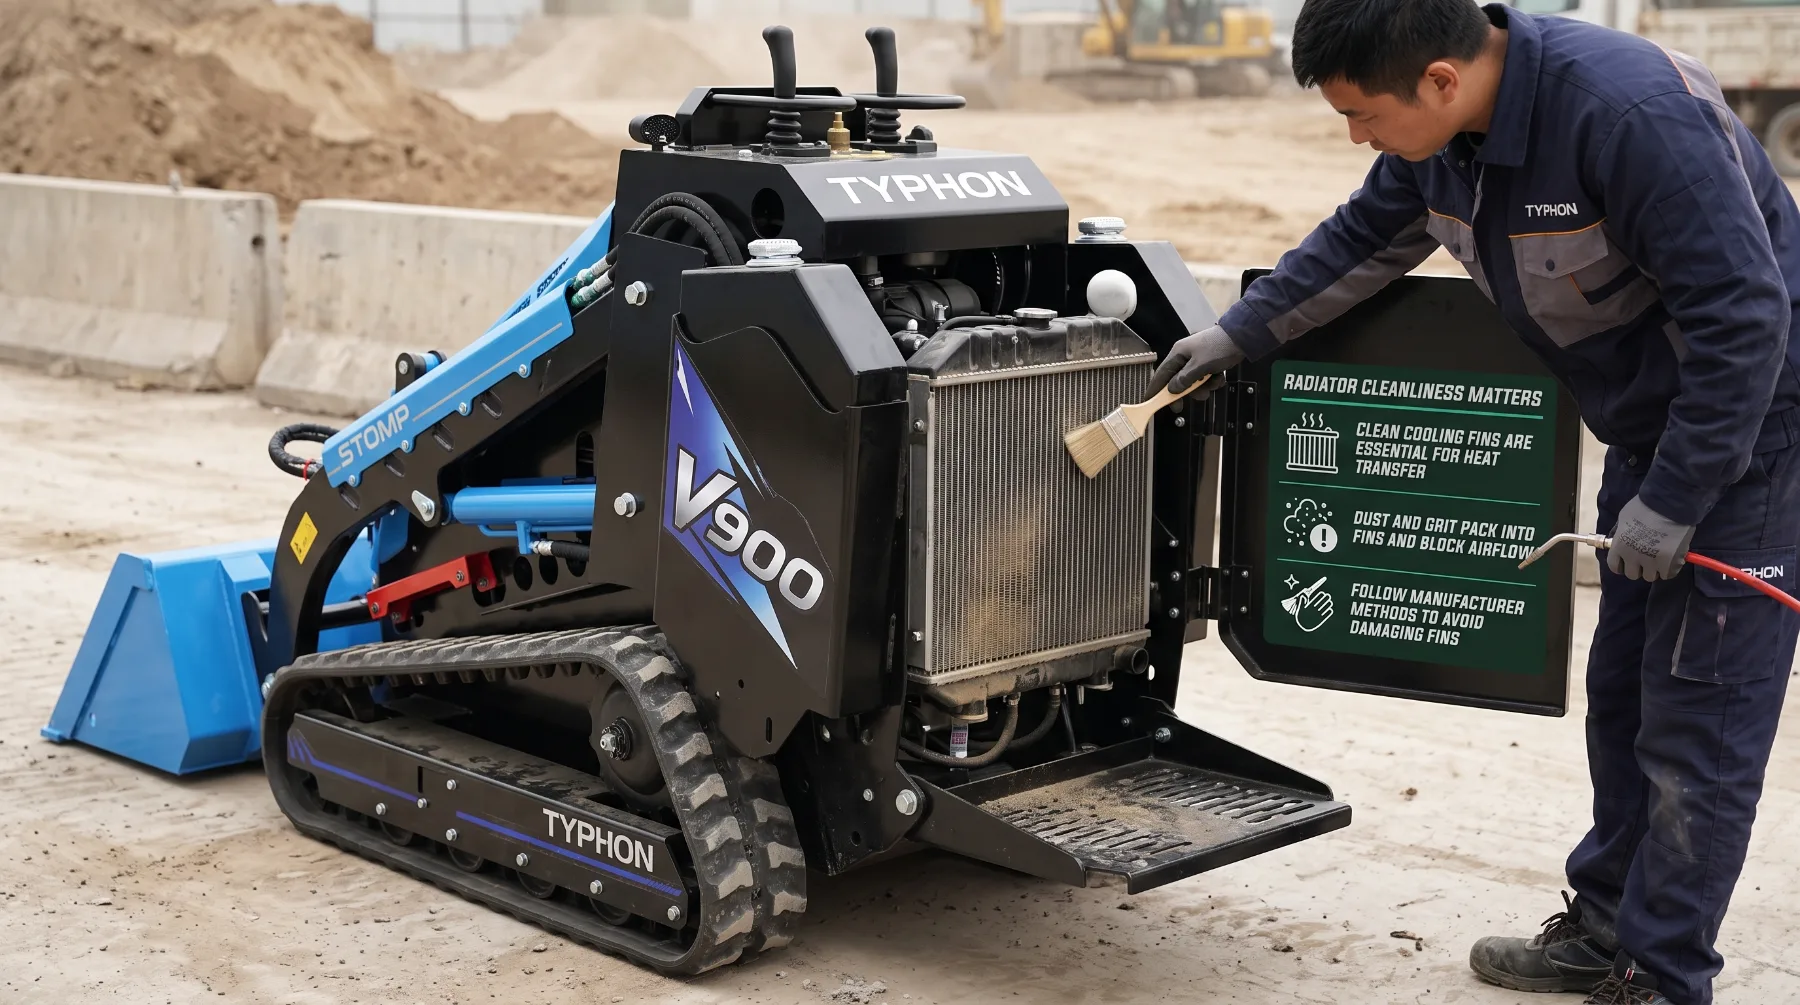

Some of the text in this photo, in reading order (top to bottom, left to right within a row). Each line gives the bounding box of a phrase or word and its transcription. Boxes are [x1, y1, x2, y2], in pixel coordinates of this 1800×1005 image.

[826, 170, 1032, 204] TYPHON
[1525, 202, 1579, 217] TYPHON
[1284, 373, 1543, 407] RADIATOR CLEANLINESS MATTERS
[337, 403, 410, 468] STOMP
[1356, 422, 1533, 450] CLEAN COOLING FINS ARE
[1356, 440, 1501, 466] ESSENTIAL FOR HEAT
[1356, 459, 1426, 479] TRANSFER
[673, 448, 824, 610] V900
[1353, 511, 1536, 541] DUST AND GRIT PACK INTO
[1353, 529, 1535, 560] FINS AND BLOCK AIRFLOW
[1351, 583, 1525, 615] FOLLOW MANUFACTURER
[1350, 602, 1484, 629] METHODS TO AVOID
[1350, 619, 1461, 646] DAMAGING FINS
[543, 807, 654, 872] TYPHON
